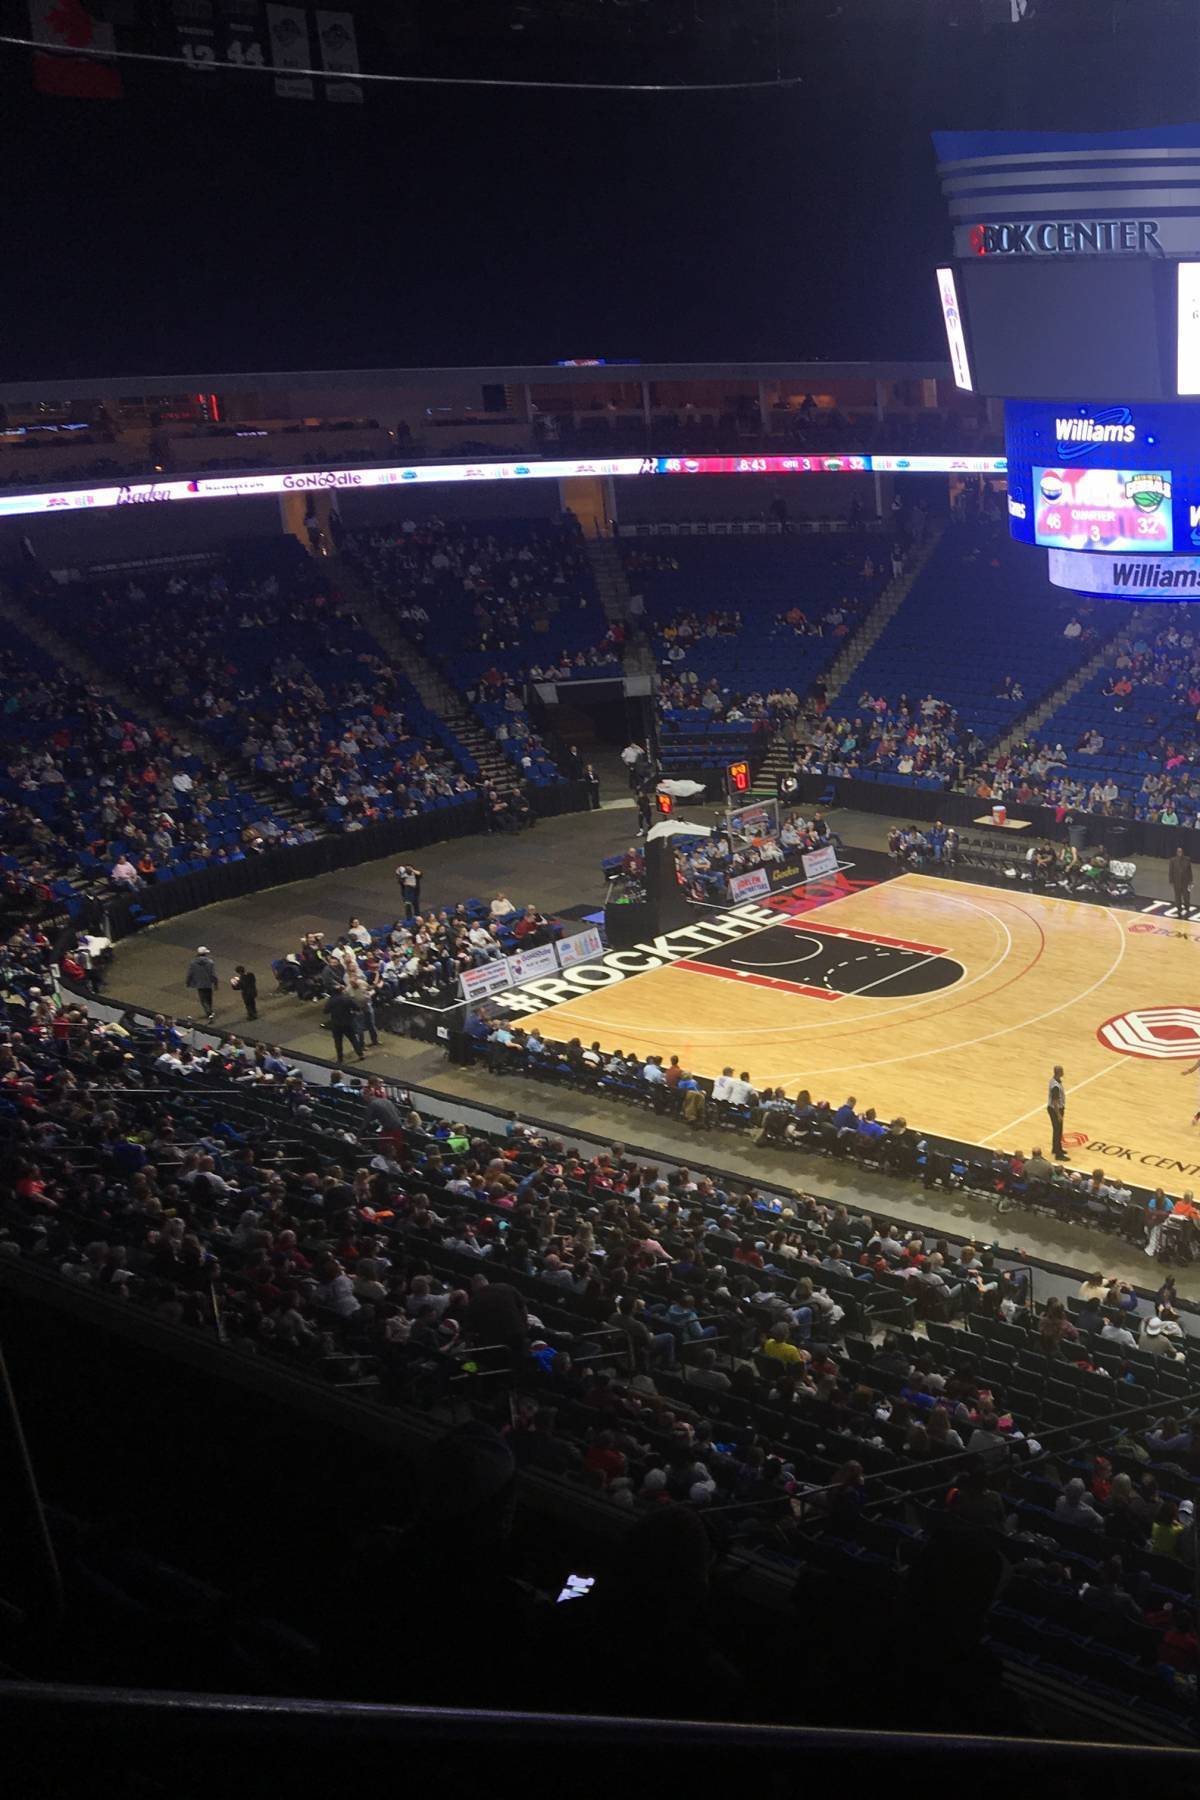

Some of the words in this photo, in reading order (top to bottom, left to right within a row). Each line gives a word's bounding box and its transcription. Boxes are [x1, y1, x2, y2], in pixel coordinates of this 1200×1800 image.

[1036, 221, 1166, 257] CENTER
[1055, 417, 1136, 443] Williams
[116, 484, 172, 506] Baden
[1090, 525, 1100, 542] 3
[1137, 517, 1160, 535] 32
[1085, 1140, 1142, 1163] BOK
